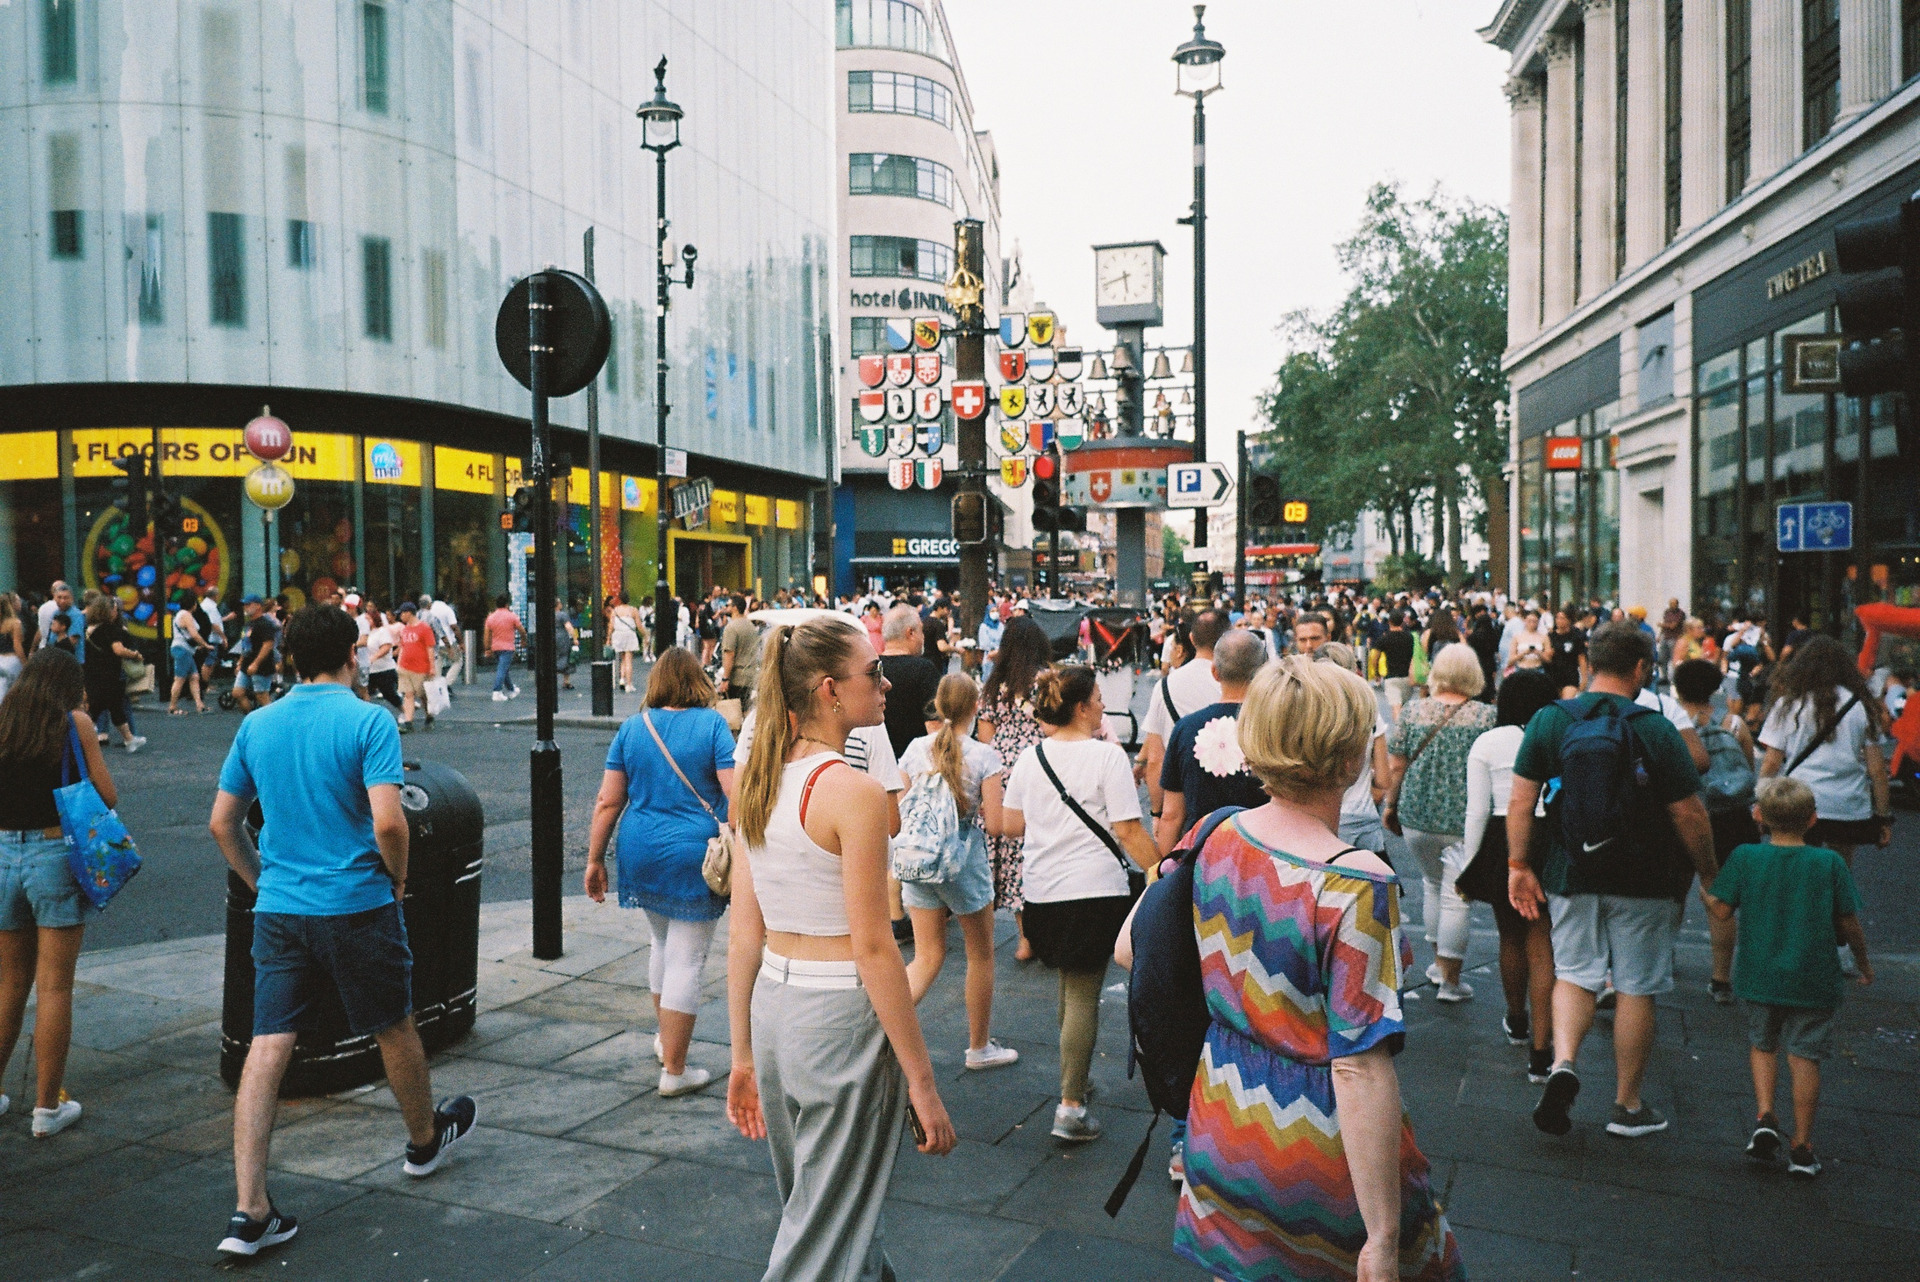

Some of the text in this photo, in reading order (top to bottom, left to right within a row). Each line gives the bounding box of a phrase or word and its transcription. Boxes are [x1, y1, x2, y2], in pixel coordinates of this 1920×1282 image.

[1766, 250, 1827, 299] TWG TEA
[850, 289, 957, 315] hotel INDIG
[261, 429, 281, 447] m
[280, 445, 317, 465] UN
[466, 463, 474, 480] 4
[1181, 470, 1197, 492] P
[261, 478, 282, 495] m
[1284, 501, 1308, 522] 03
[183, 518, 199, 533] 03
[908, 538, 961, 555] GREGG
